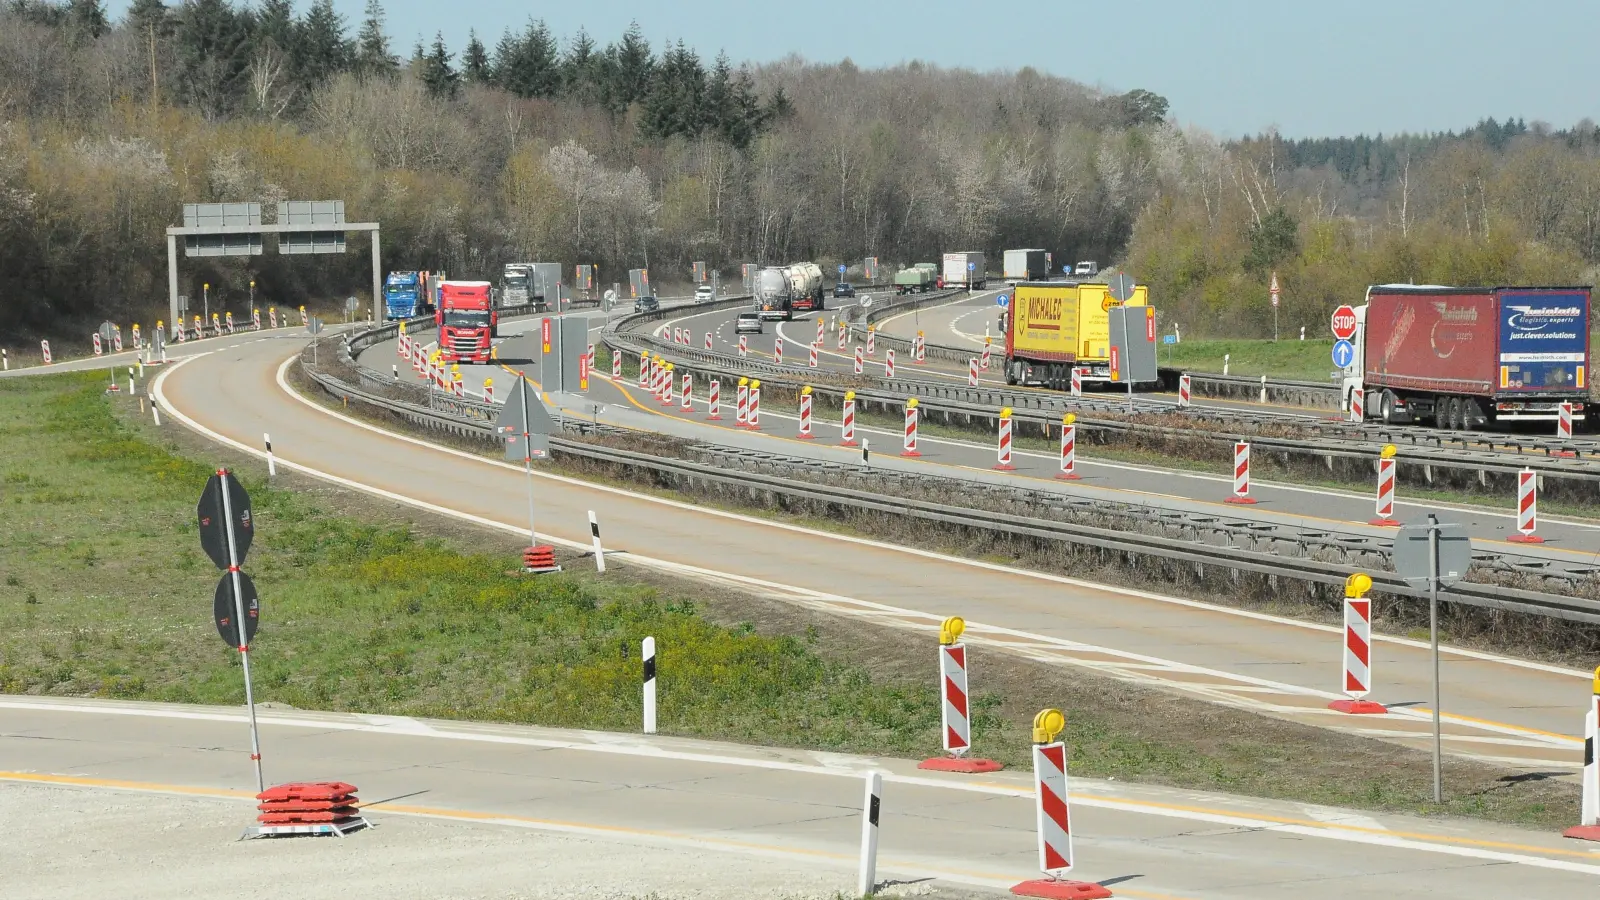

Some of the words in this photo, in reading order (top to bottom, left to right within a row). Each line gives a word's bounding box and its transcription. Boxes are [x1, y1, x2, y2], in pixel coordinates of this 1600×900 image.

[1028, 297, 1062, 320] MICHALEC
[1333, 315, 1355, 329] STOP
[1509, 332, 1576, 341] just.clever.solutions
